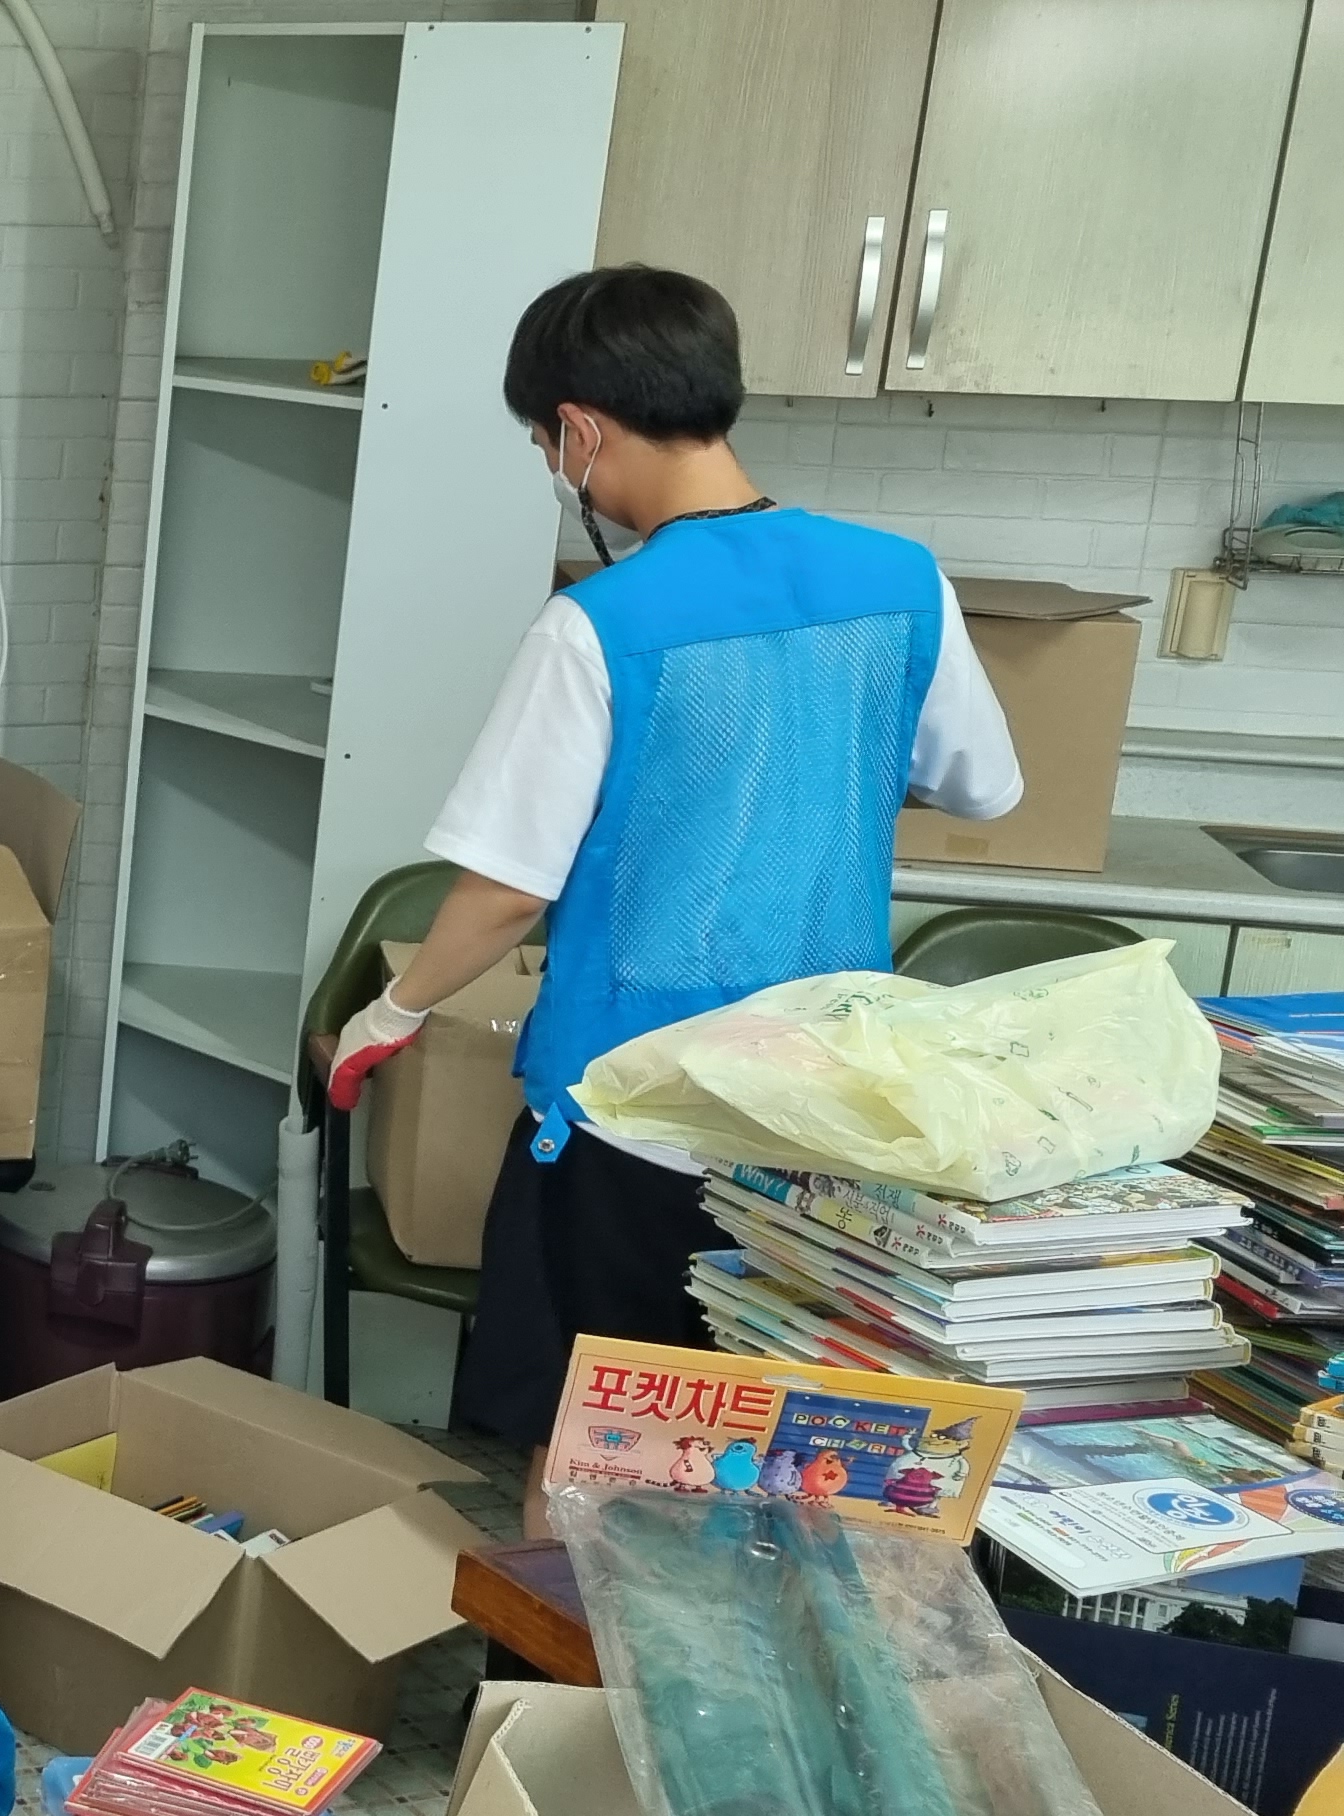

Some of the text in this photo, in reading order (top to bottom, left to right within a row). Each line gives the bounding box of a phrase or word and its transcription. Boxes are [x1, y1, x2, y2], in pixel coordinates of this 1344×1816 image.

[581, 1364, 778, 1433] 포켓차트
[793, 1412, 906, 1436] POCKET
[811, 1436, 905, 1455] CHART
